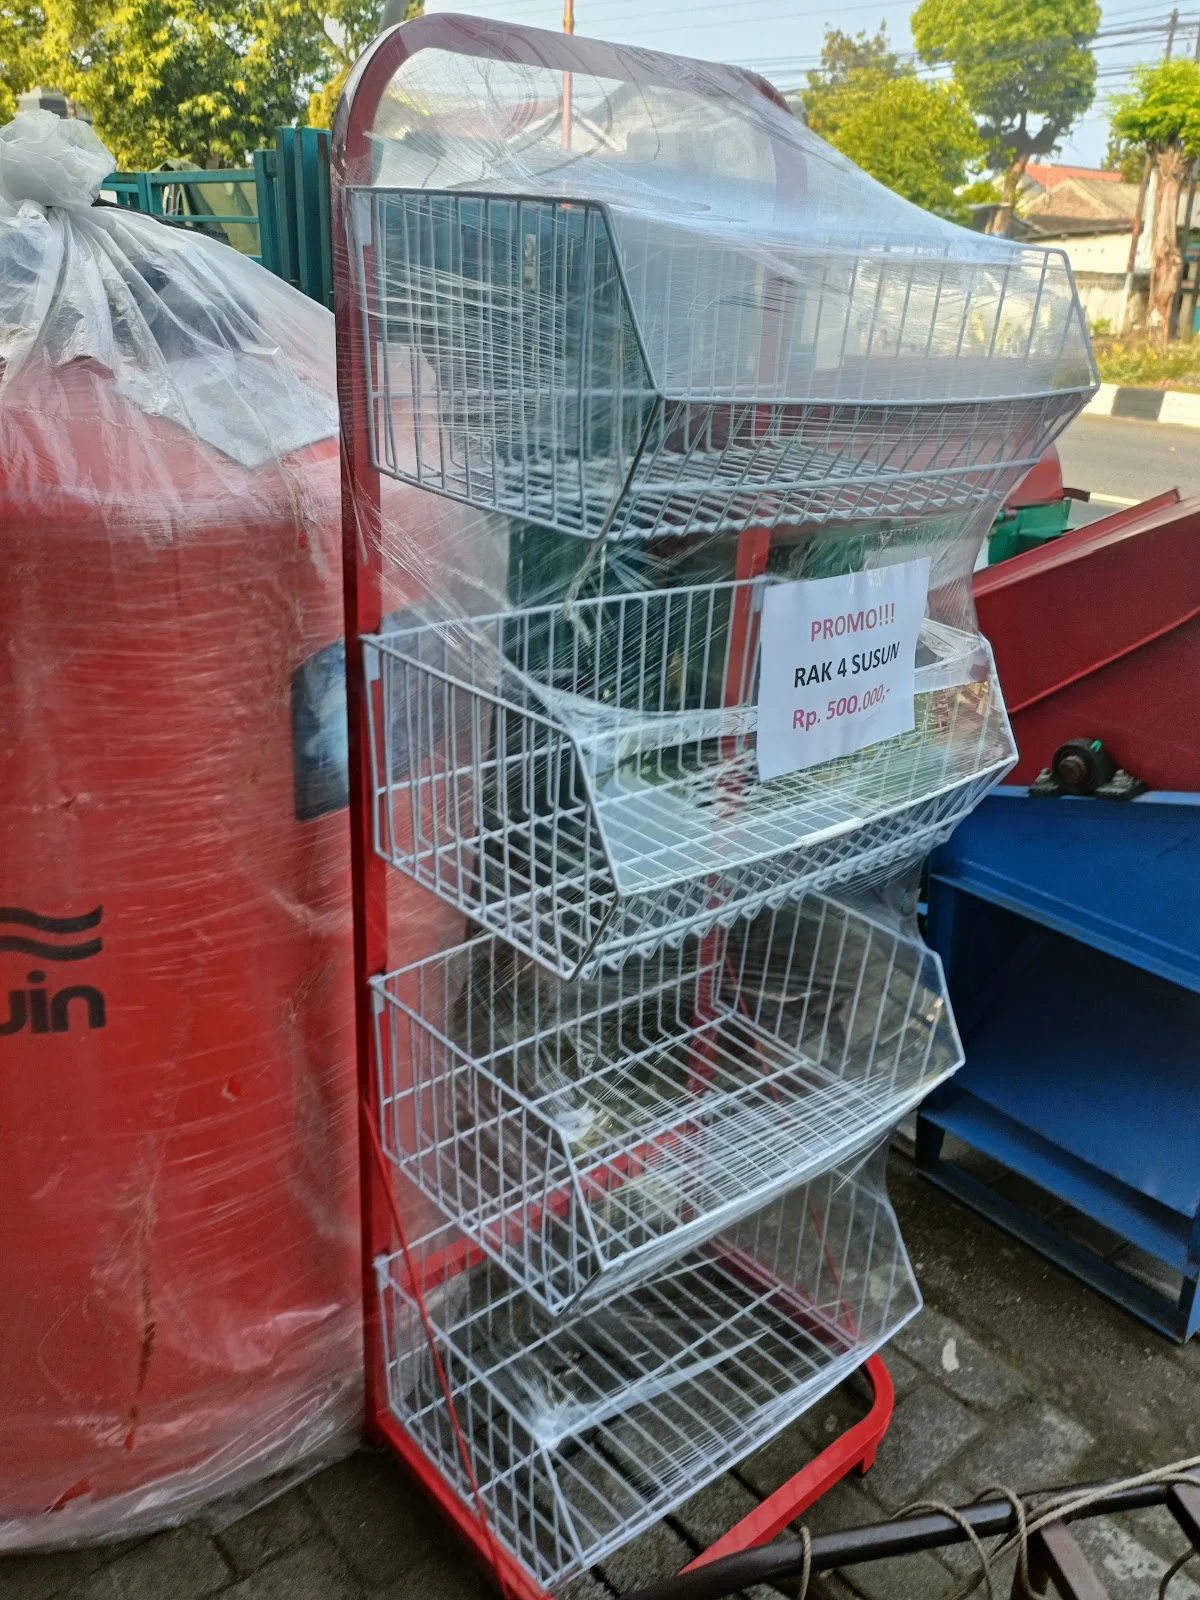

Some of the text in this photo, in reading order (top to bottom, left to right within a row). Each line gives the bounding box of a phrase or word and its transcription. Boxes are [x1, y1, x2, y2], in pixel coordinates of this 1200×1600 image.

[810, 602, 895, 642] PROMO!!!
[794, 641, 900, 688] RAK 4 SUSUN
[792, 684, 891, 731] Rp. 500.000,-
